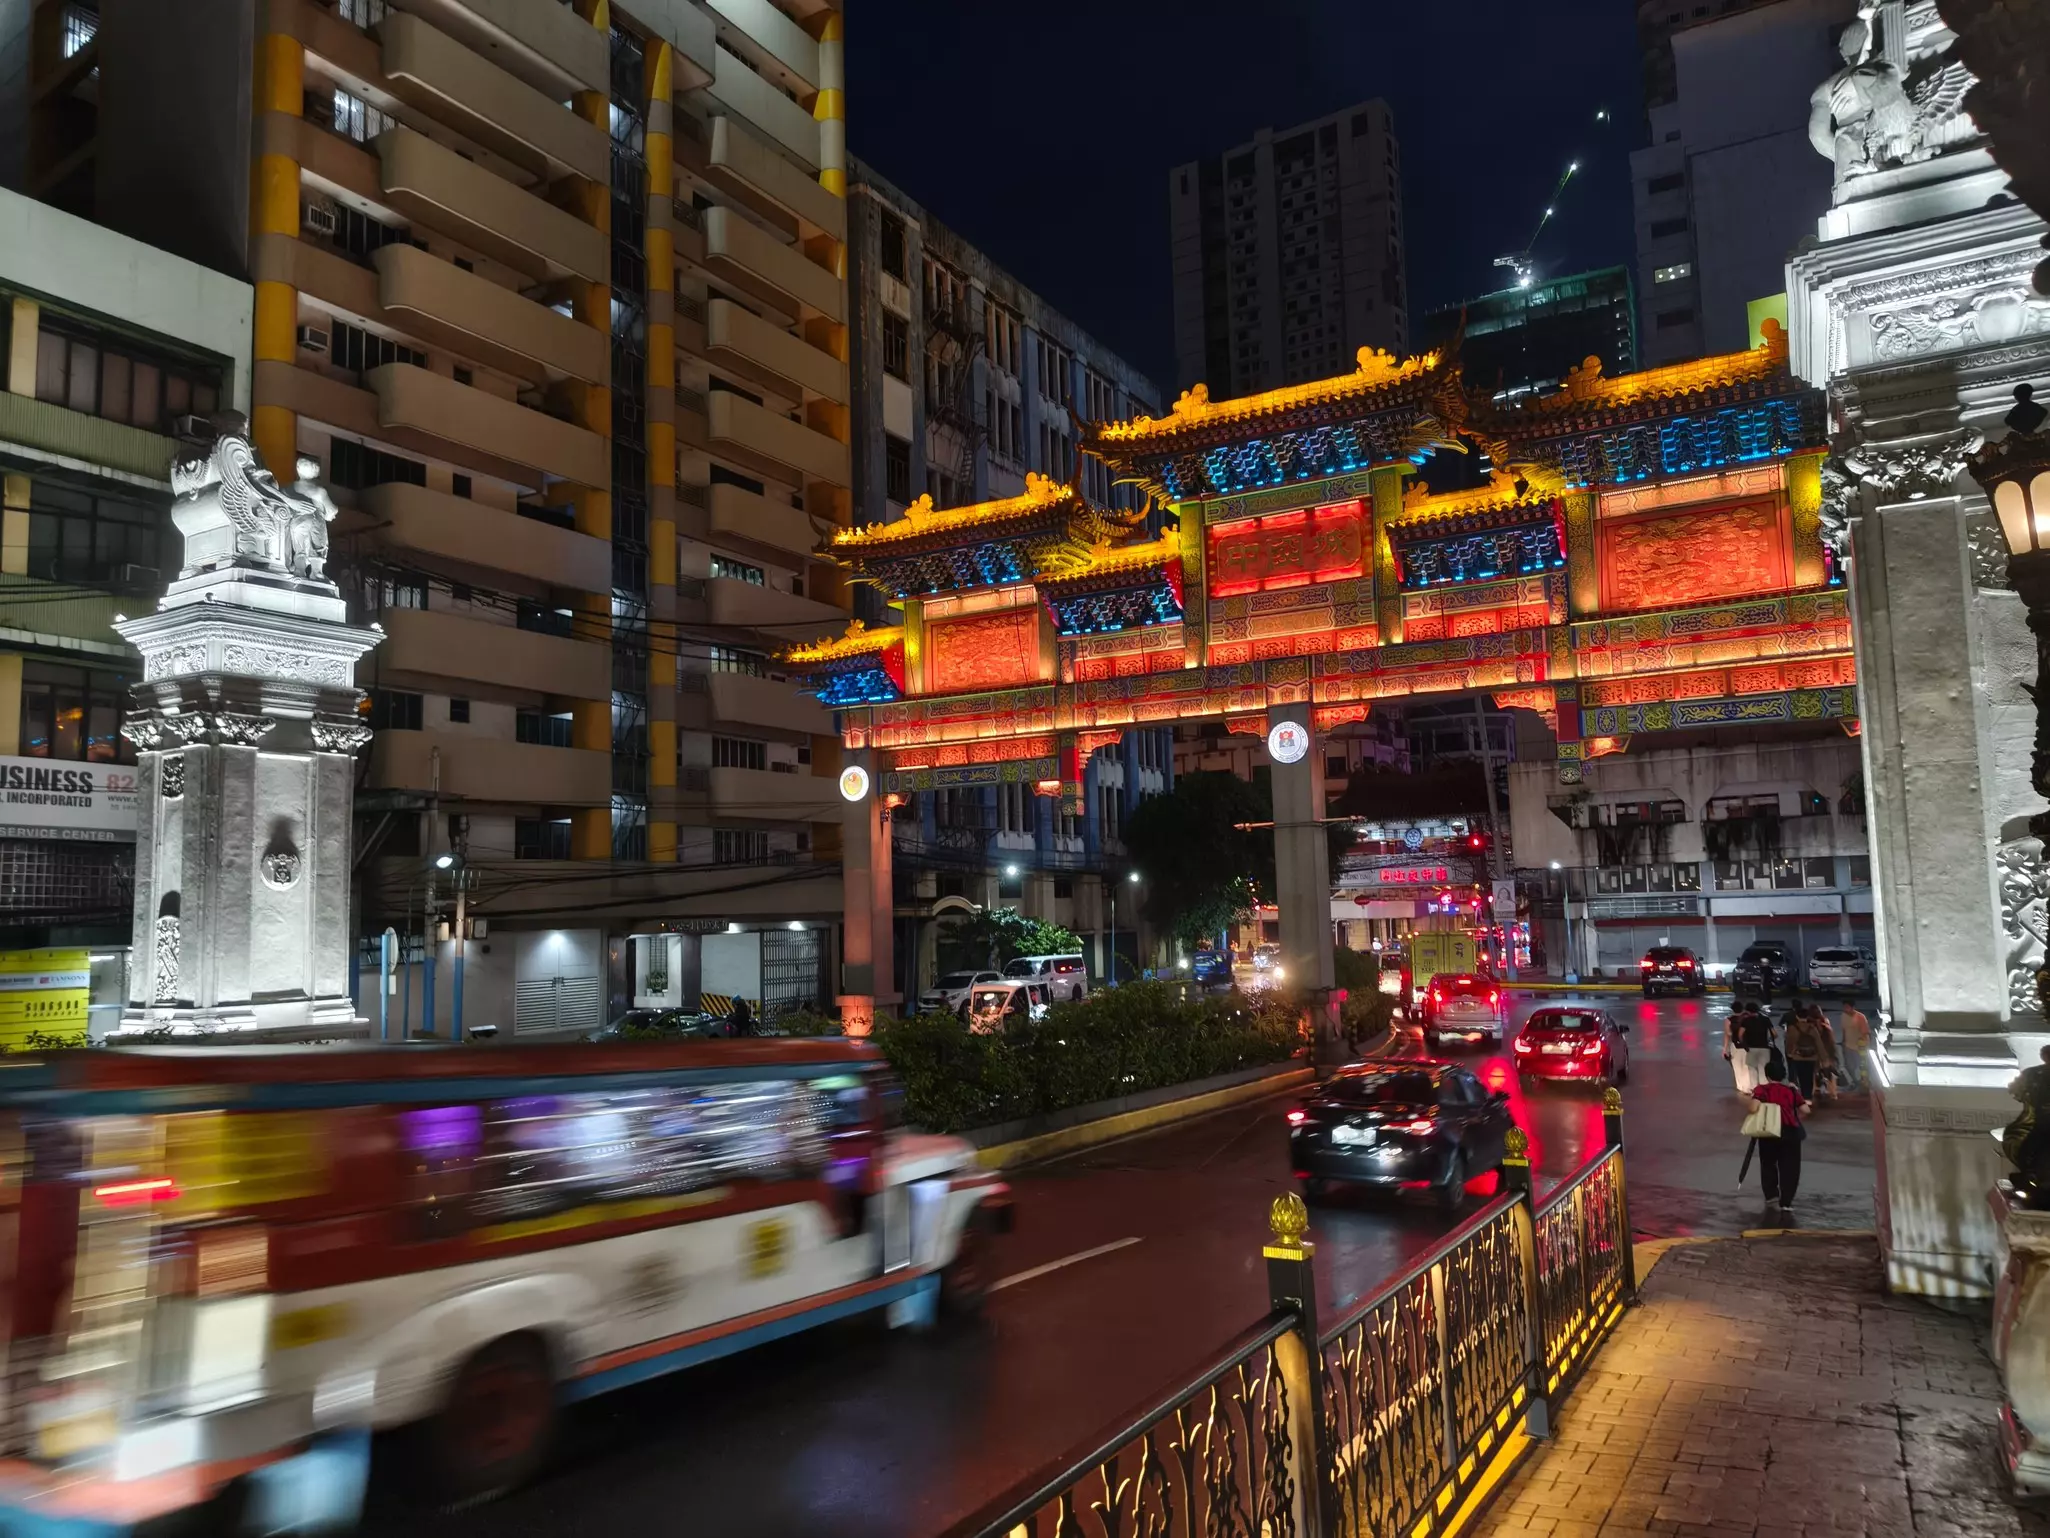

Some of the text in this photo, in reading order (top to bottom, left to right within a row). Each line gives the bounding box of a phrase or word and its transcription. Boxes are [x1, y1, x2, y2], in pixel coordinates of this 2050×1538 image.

[7, 792, 92, 808] INCORPORATED
[0, 827, 115, 841] SERVICE CENTER
